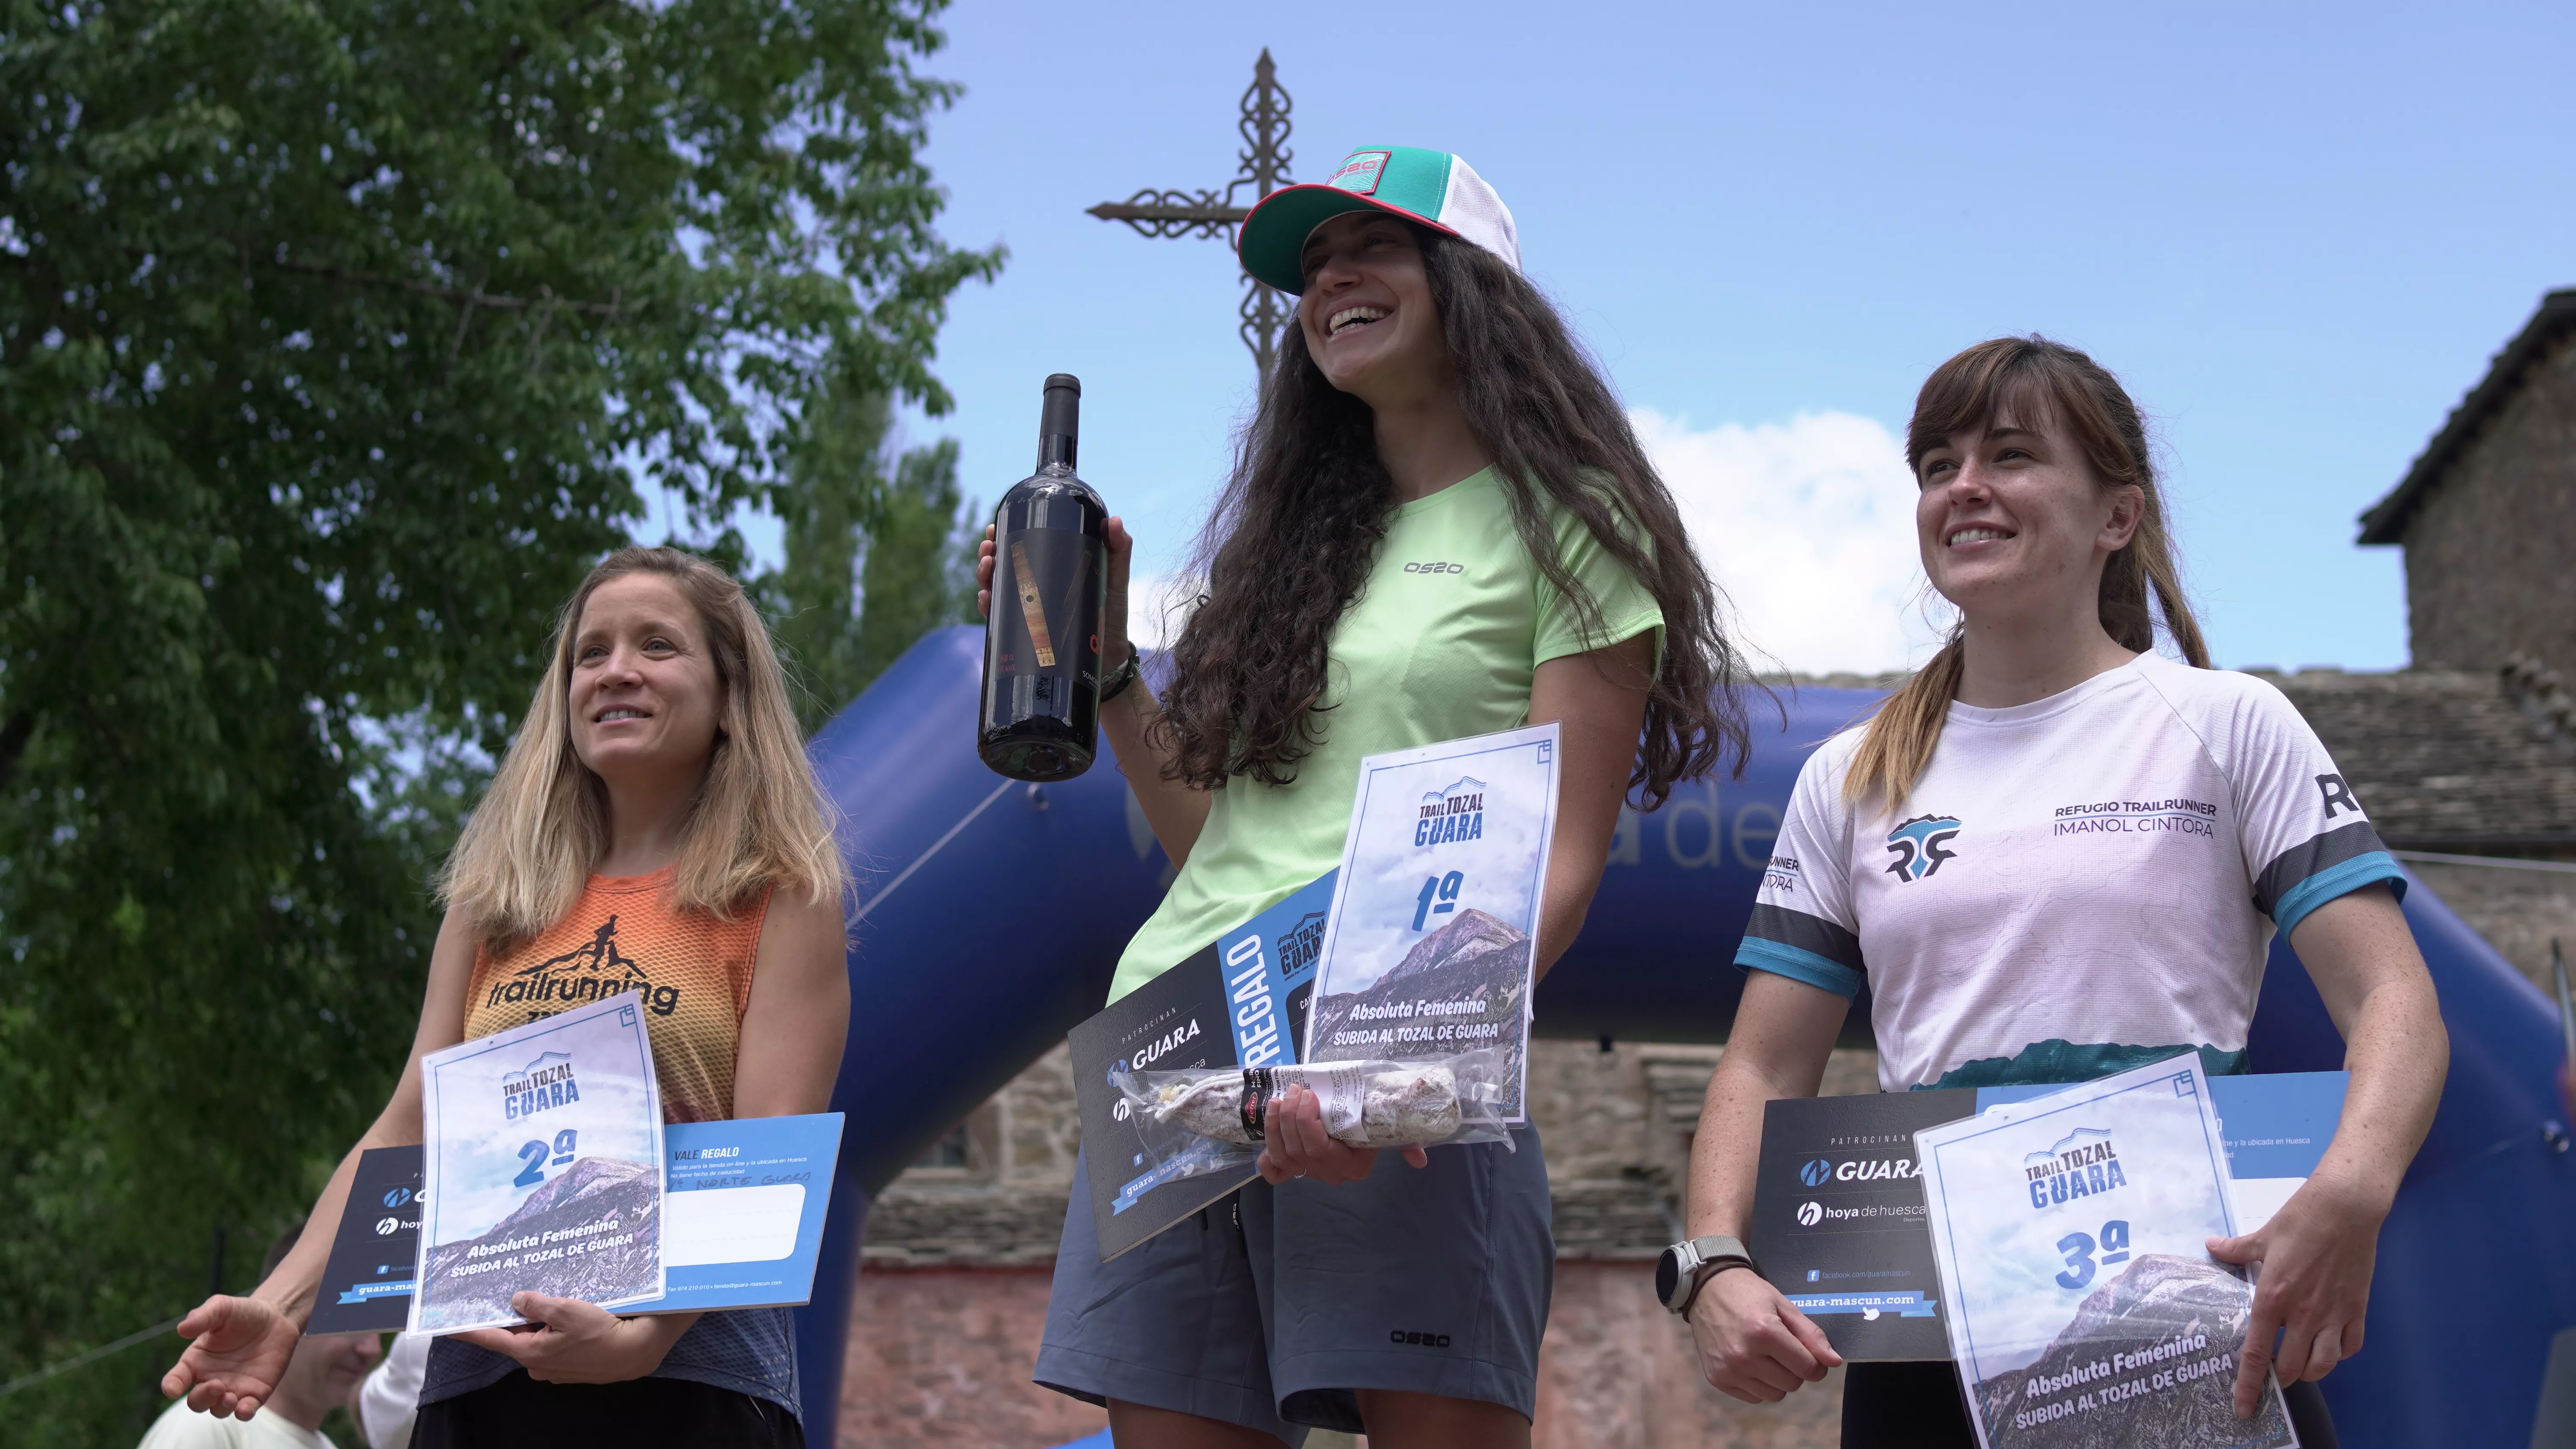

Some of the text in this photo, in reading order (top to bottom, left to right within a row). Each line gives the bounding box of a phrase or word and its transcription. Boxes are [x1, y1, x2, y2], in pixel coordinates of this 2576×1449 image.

[1420, 793, 1483, 818] TRAIL TOZAL
[2055, 799, 2217, 817] REFUGIO TRAILRUNNER
[1415, 812, 1482, 846] GUARA
[2054, 817, 2214, 839] IMANOL CINTORA
[1278, 938, 1299, 957] TRAIL
[1280, 934, 1325, 976] GUAR
[486, 971, 680, 1016] trailrunning
[1227, 934, 1280, 1069] REGALO
[1349, 995, 1486, 1021] Absoluta Femenina
[1122, 1007, 1176, 1044] PATROCINAN
[1333, 1022, 1498, 1046] SUBIDA AL TOZAL DE GUARA
[1133, 1018, 1201, 1070] GUARA
[503, 1063, 574, 1096] TRAIL TOZAL
[505, 1079, 580, 1119] GUARA
[674, 1147, 739, 1161] VALE REGALO
[1831, 1134, 1906, 1145] PATROCINAN
[513, 1129, 577, 1188] 2ª
[2025, 1140, 2117, 1181] TRAIL TOZAL
[696, 1176, 753, 1191] NORTE
[761, 1172, 811, 1185] GUARA
[2029, 1159, 2127, 1209] GUARA
[1826, 1204, 1926, 1219] hoya de huesca
[450, 1233, 633, 1278] SUBIDA AL TOZAL DE GUARA
[467, 1220, 619, 1259] Absoluta Femenina
[2055, 1220, 2129, 1289] 3ª
[714, 1280, 782, 1289] tienda@guara-mascun.com
[1822, 1269, 1910, 1279] facebook.com/guaramascun
[2027, 1335, 2206, 1398] Absoluta Femenina
[2016, 1354, 2233, 1429] SUBIDA AL TOZAL DE GUARA
